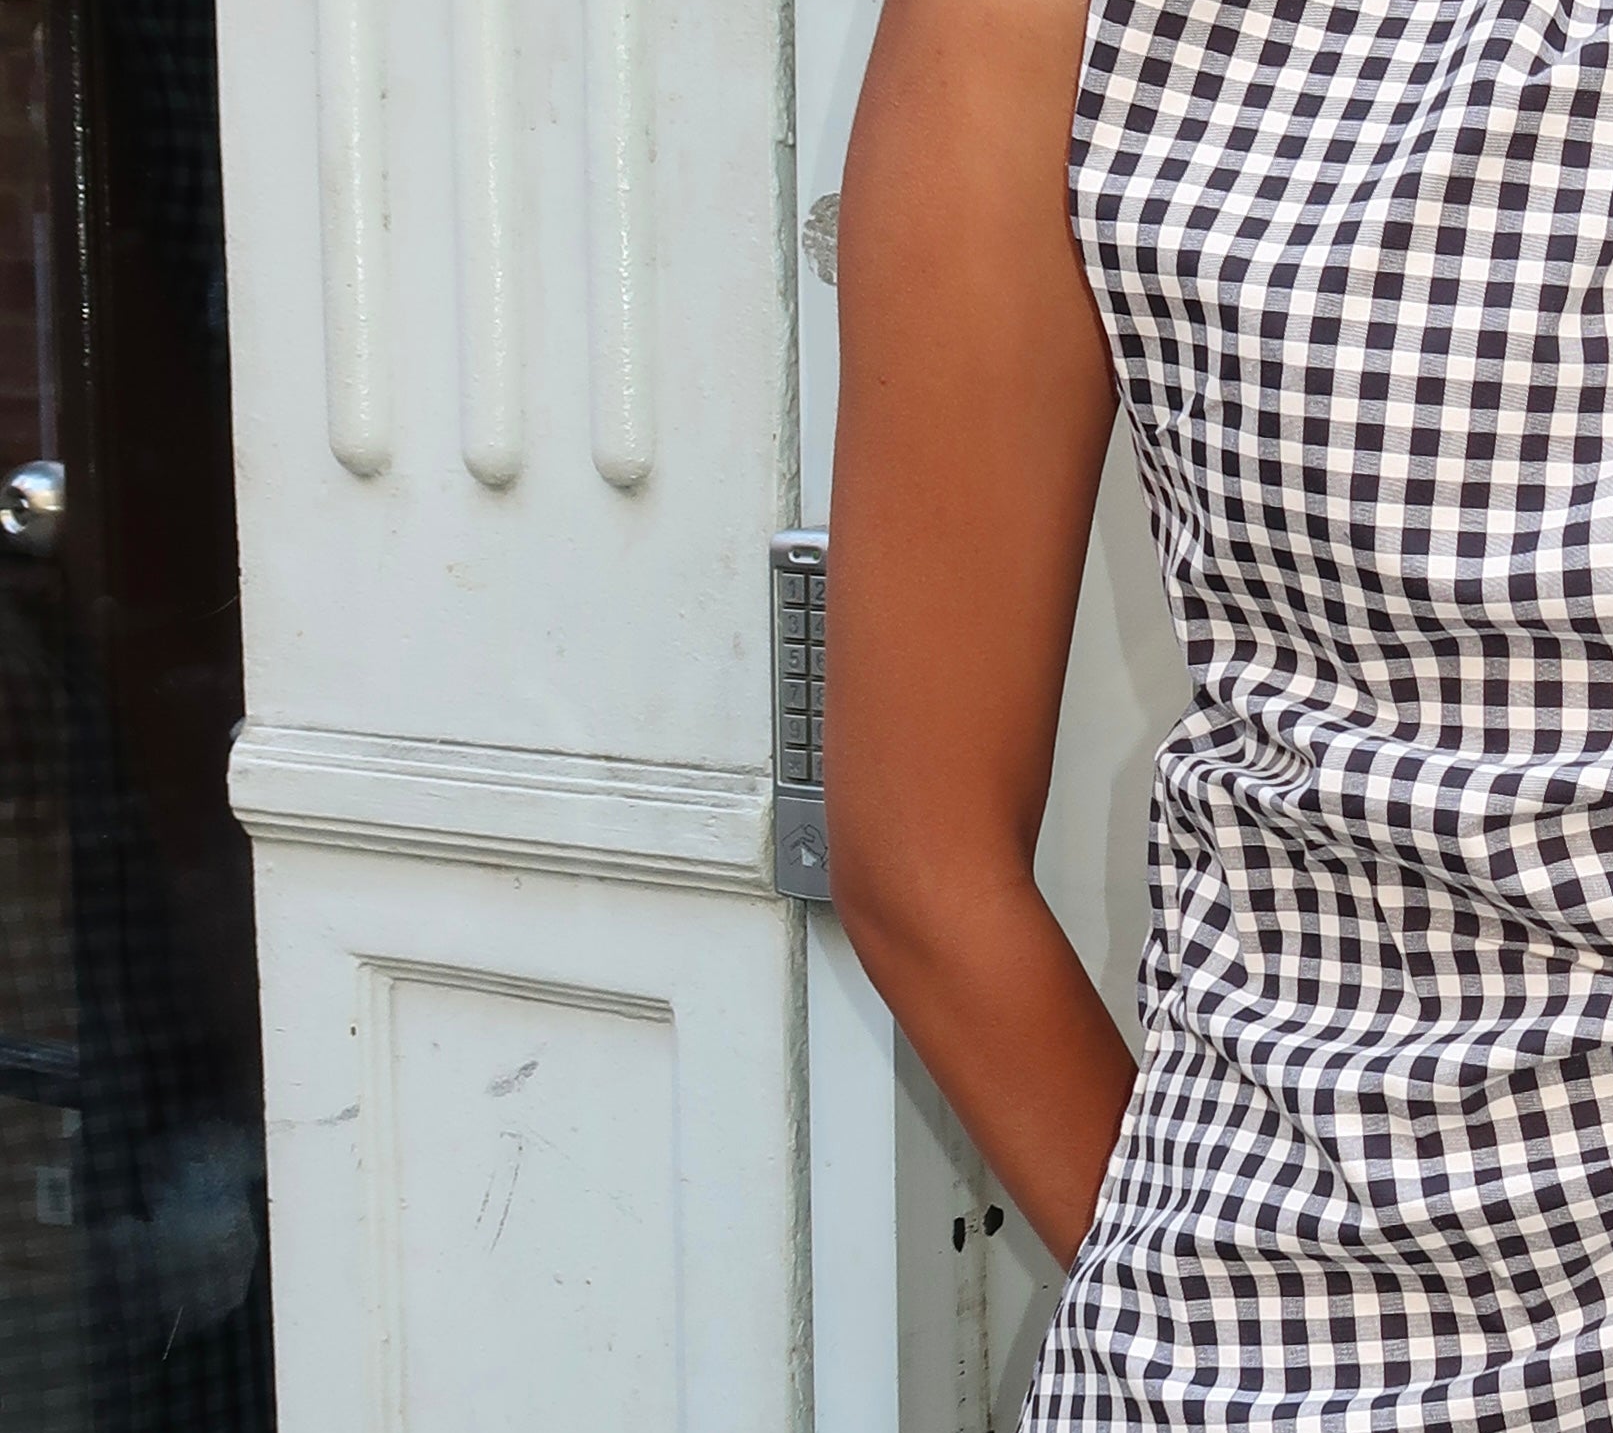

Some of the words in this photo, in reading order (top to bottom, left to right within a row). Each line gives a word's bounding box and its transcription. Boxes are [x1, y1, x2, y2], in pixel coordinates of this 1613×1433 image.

[788, 578, 796, 599] 1
[815, 580, 826, 602] 2
[788, 613, 799, 634] 3
[788, 649, 800, 669] 5
[790, 683, 800, 701] 7
[789, 719, 801, 739] 9
